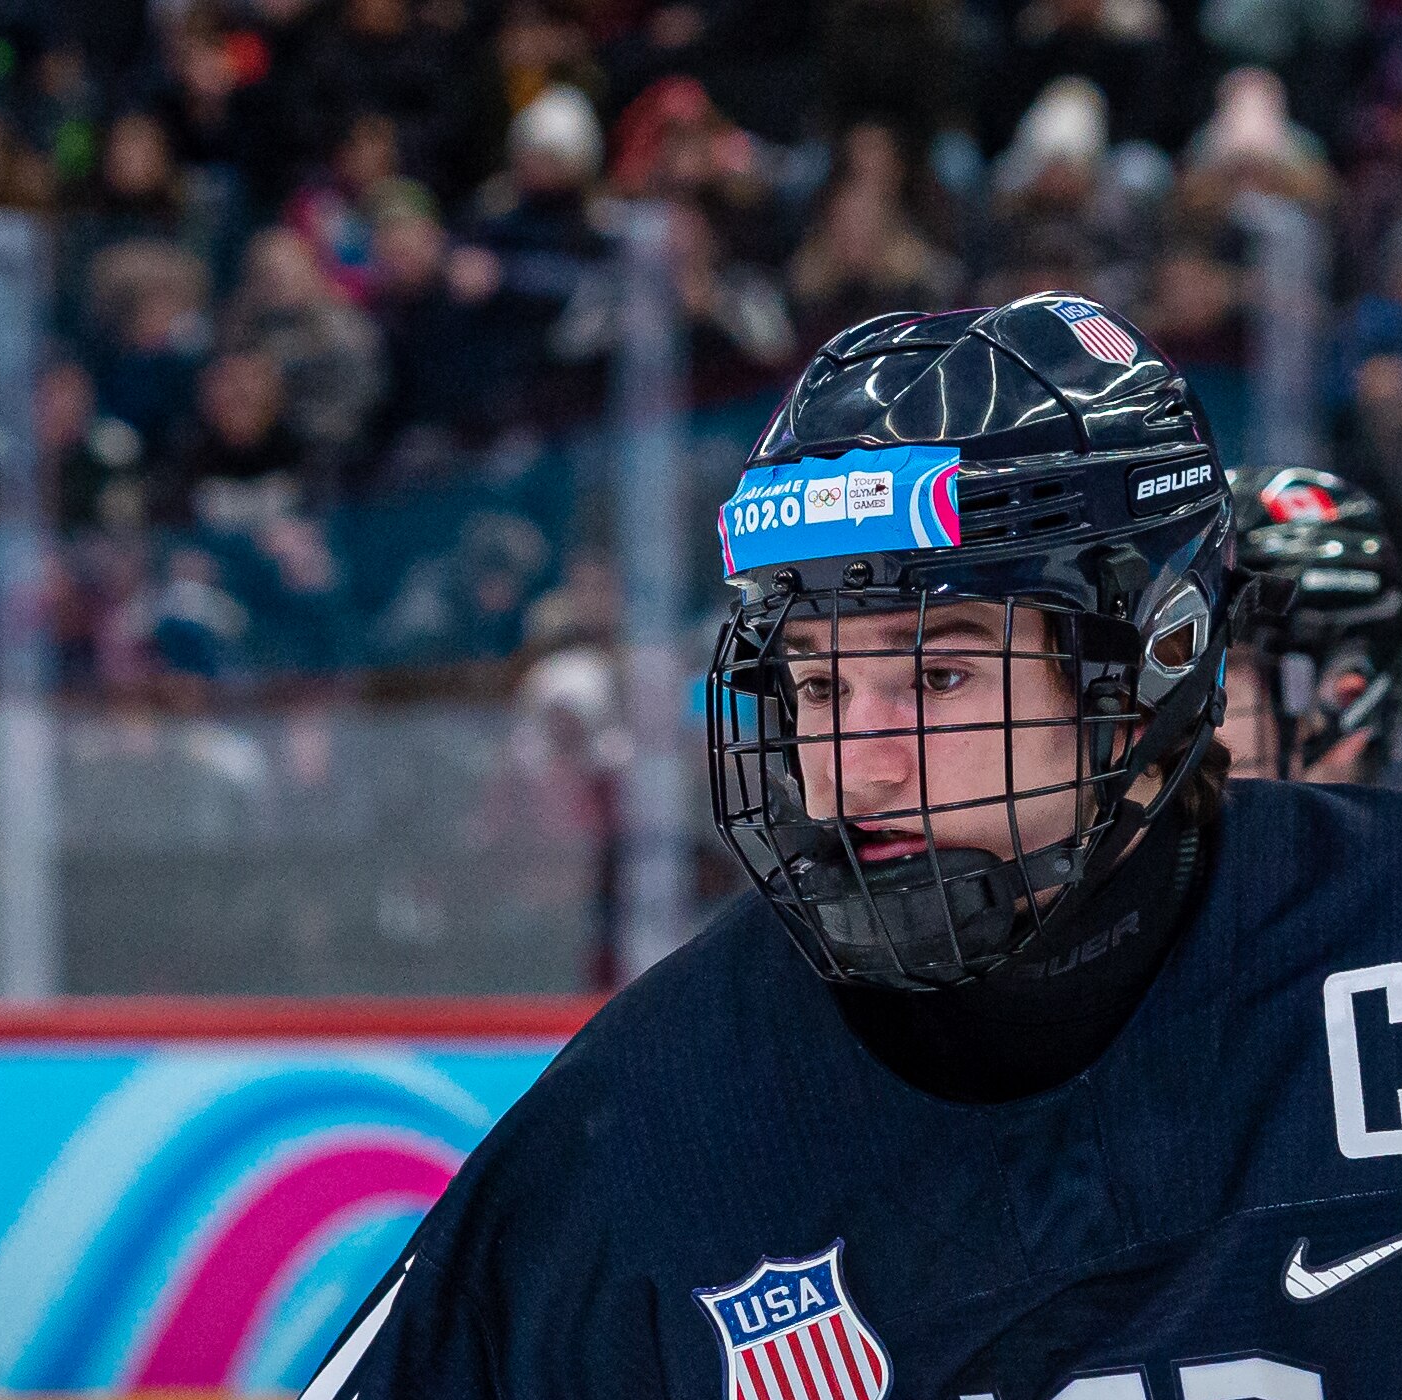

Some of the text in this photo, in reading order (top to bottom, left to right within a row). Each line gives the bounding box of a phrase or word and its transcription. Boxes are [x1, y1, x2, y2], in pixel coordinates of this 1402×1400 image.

[1061, 303, 1094, 320] USA
[734, 496, 801, 537] 2020
[853, 498, 886, 510] GAMES
[734, 1276, 827, 1334] USA
